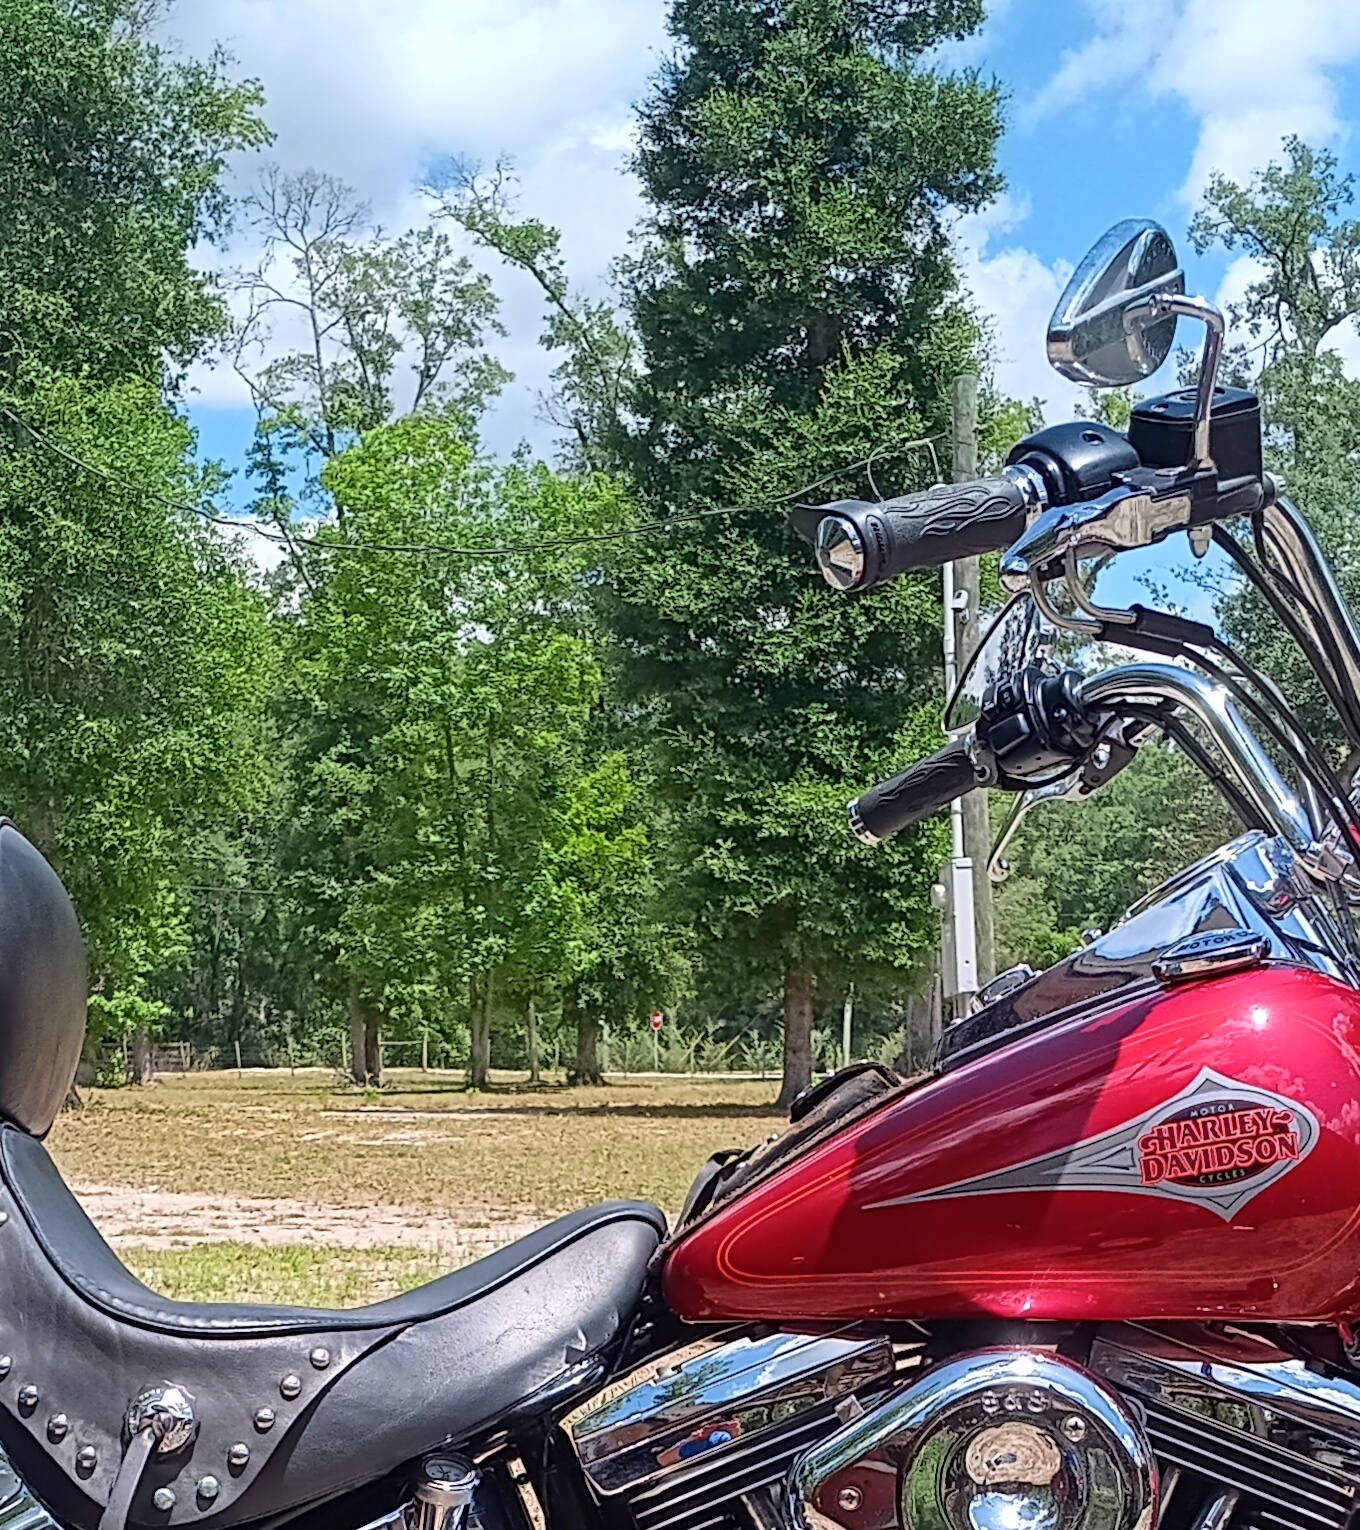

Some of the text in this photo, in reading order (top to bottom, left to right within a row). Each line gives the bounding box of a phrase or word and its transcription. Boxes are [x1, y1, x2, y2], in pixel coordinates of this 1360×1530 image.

[1190, 1103, 1236, 1118] MOTOR
[1140, 1131, 1300, 1186] DAVIDSON
[1199, 1168, 1246, 1184] CYCLES
